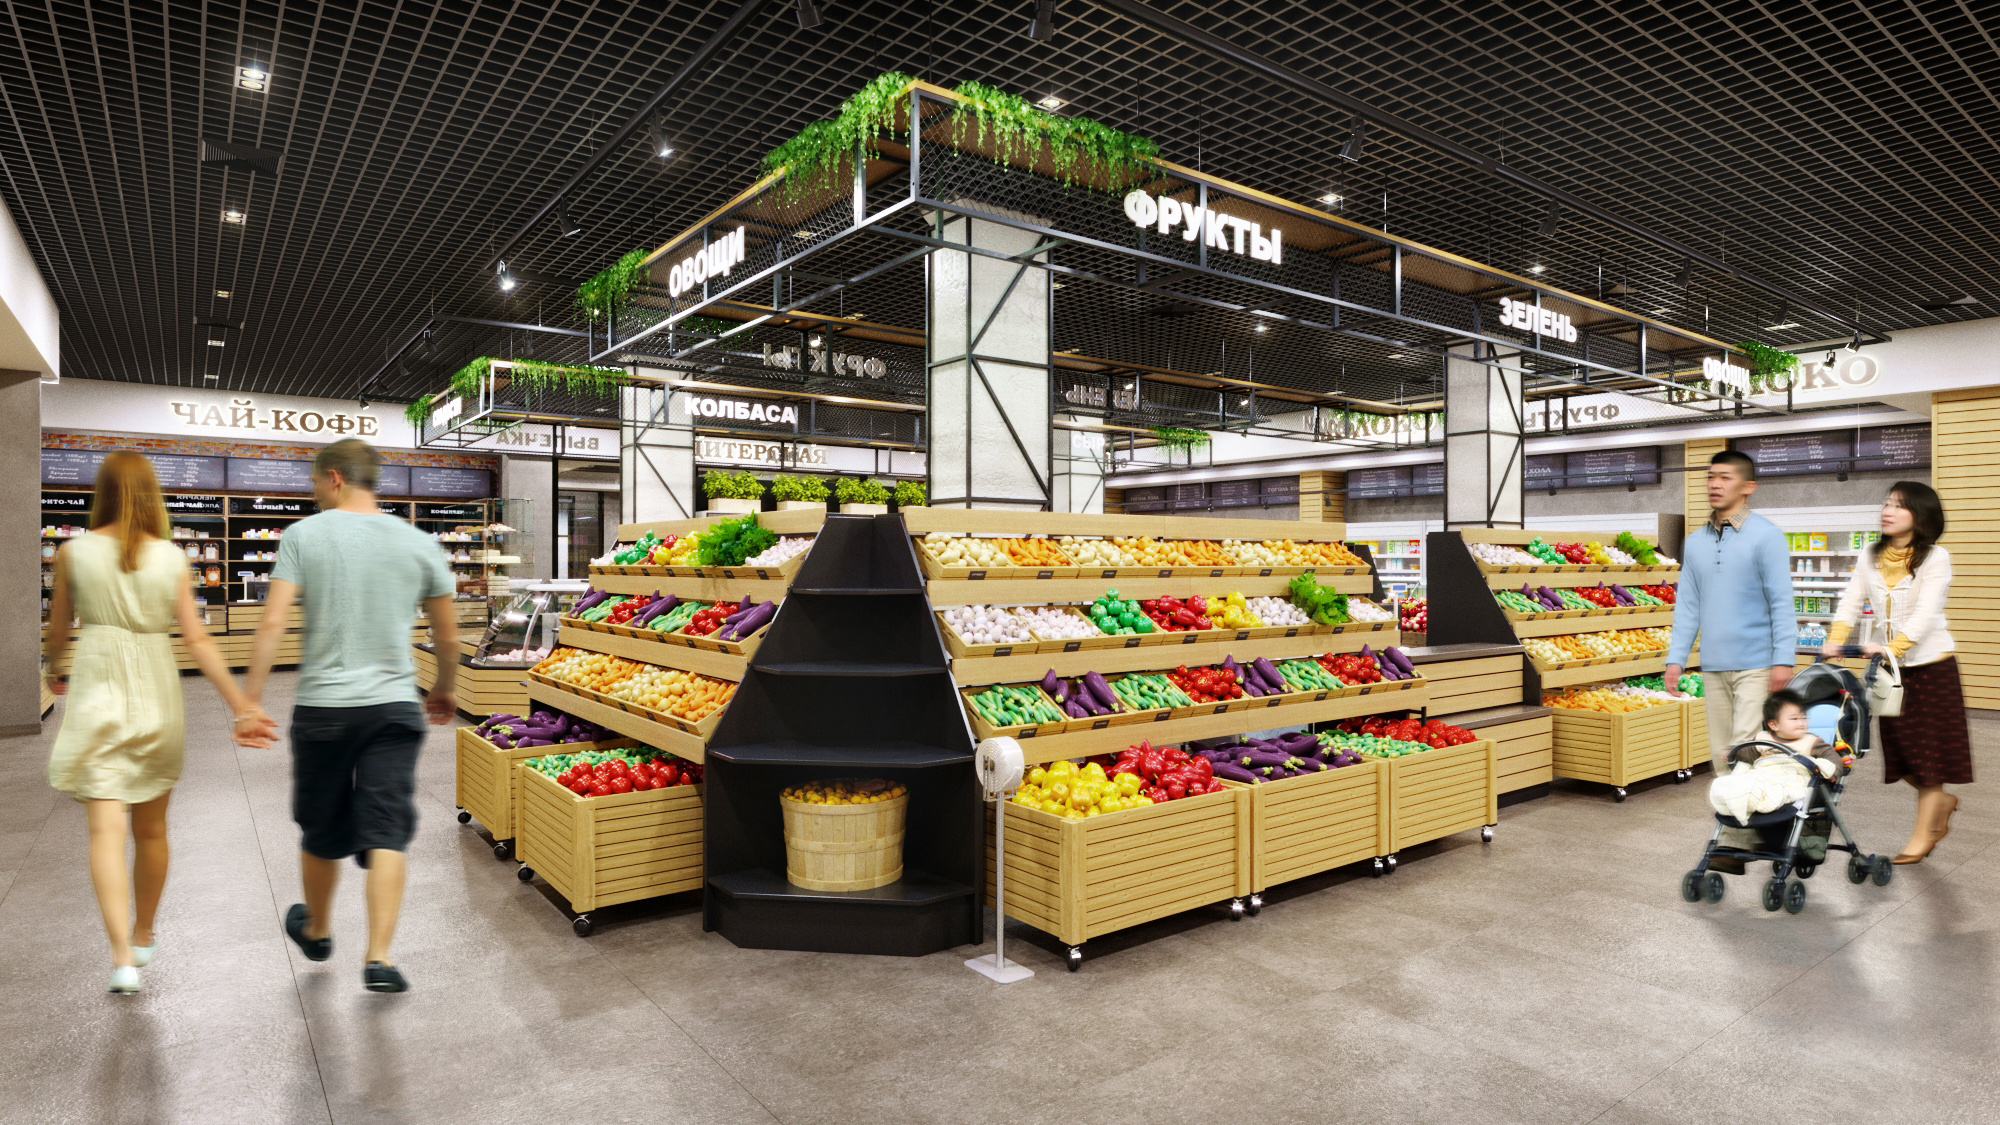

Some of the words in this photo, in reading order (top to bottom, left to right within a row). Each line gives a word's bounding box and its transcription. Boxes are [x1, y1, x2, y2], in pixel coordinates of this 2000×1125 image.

[1124, 189, 1282, 265] ФРУКТЫ
[669, 225, 745, 298] ОВОЩИ
[1499, 297, 1577, 342] ЗЕЛЕНЬ
[1703, 357, 1750, 392] ОВОЩИ
[171, 399, 379, 437] ЧАЙ-КОФЕ
[685, 396, 797, 425] КОЛБАСА
